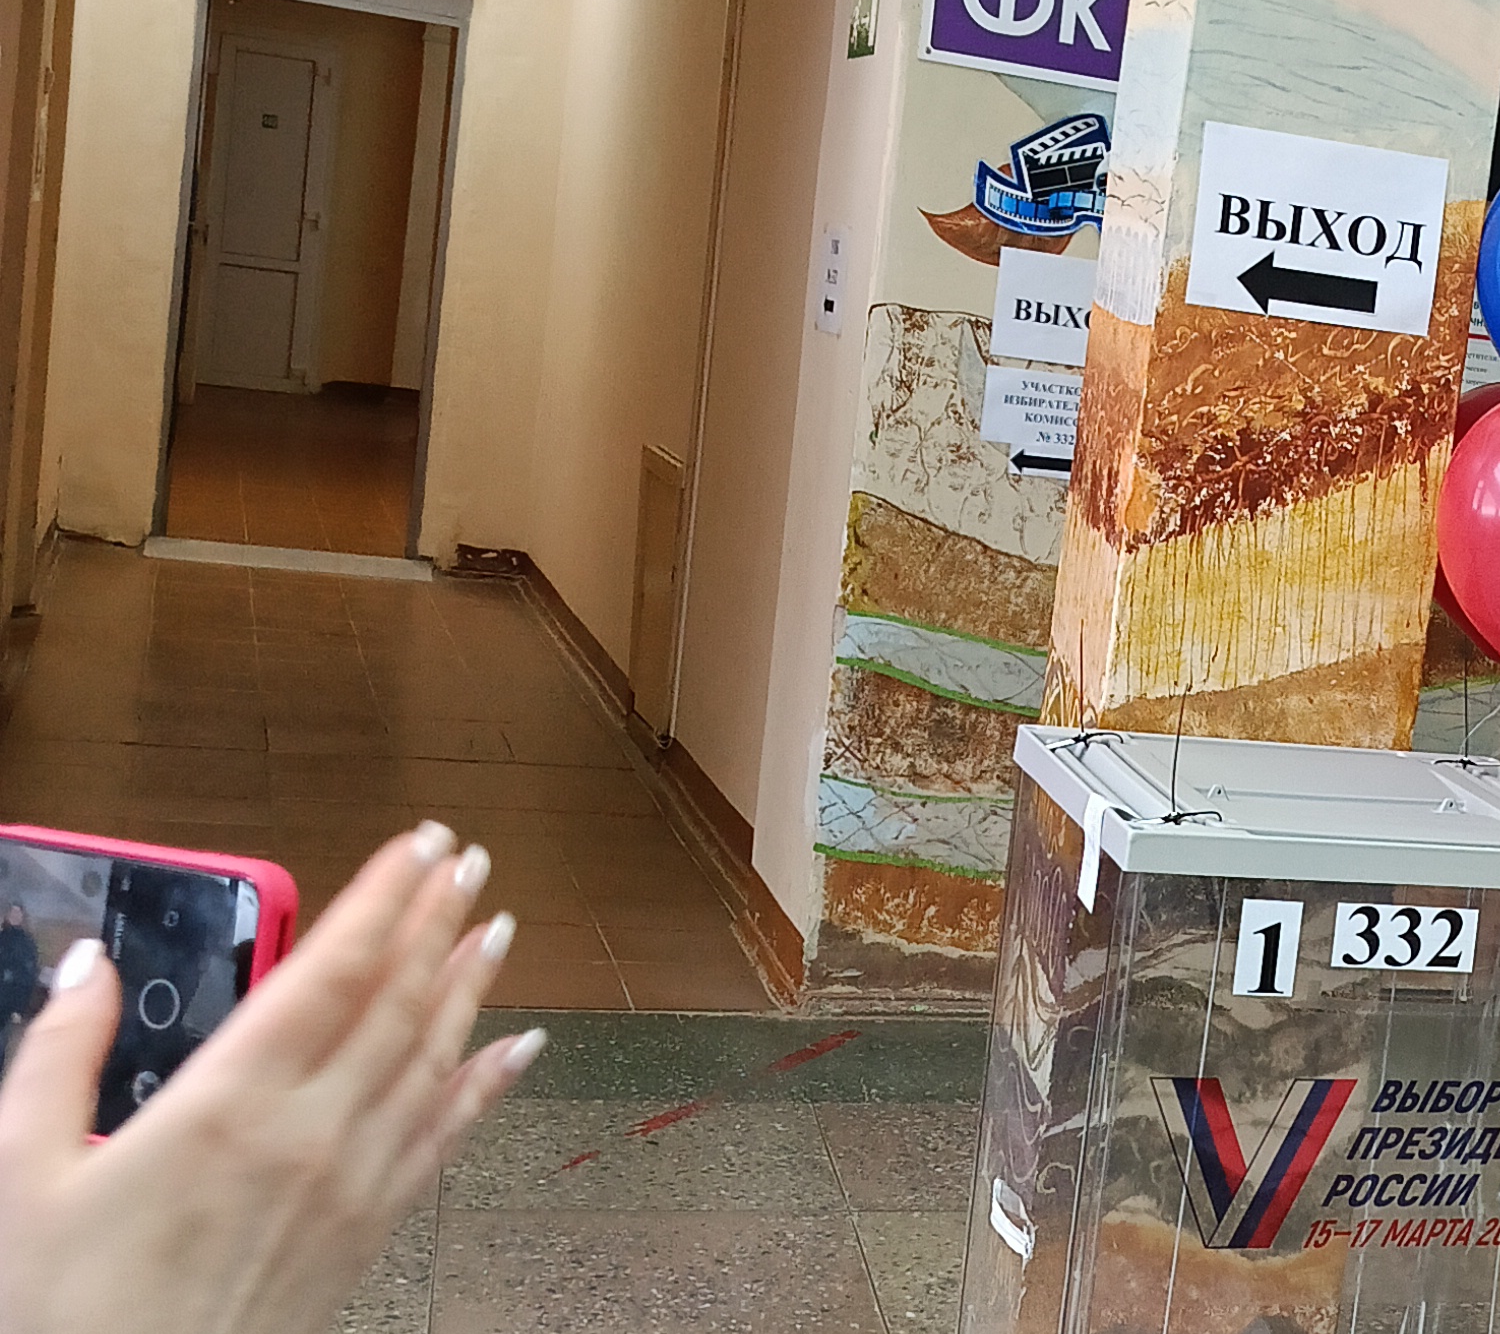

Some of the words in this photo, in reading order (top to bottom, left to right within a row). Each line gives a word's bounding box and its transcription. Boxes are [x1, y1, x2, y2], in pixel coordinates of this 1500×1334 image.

[1214, 192, 1427, 275] ВЫХОД
[1036, 431, 1051, 443] №
[1053, 433, 1075, 446] 332
[1247, 922, 1284, 994] 1
[1341, 906, 1465, 968] 332
[1322, 1174, 1481, 1208] РОССИИ
[1384, 1220, 1473, 1248] МАРТА
